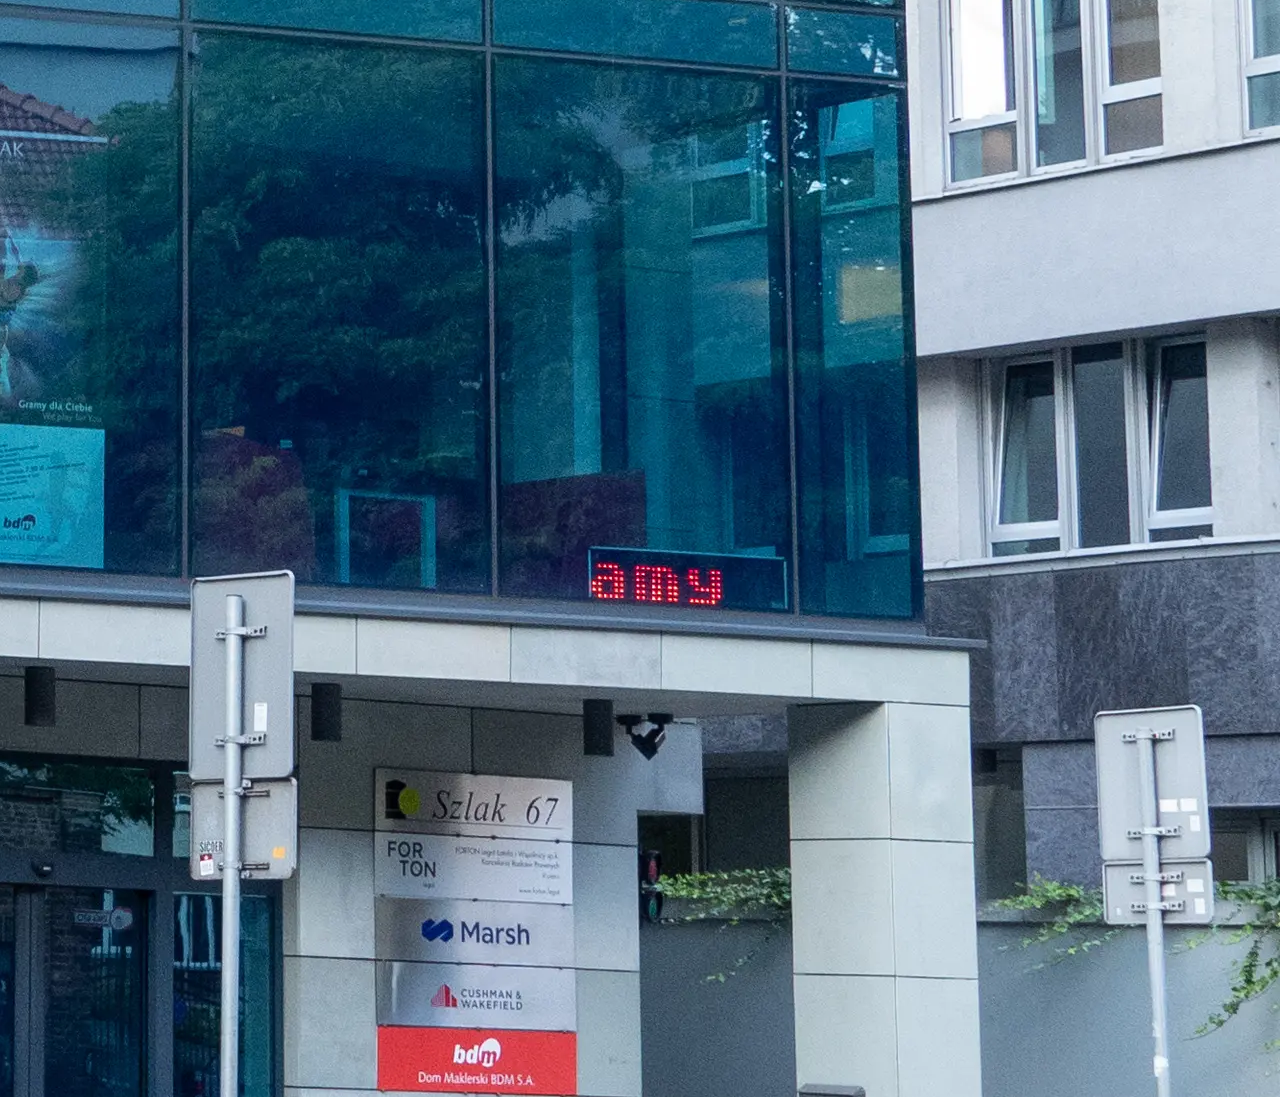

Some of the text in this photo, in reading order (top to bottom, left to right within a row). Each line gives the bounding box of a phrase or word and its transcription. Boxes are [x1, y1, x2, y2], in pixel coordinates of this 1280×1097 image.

[18, 399, 93, 413] Gramy dla Ciebie
[591, 562, 722, 605] amy
[431, 789, 560, 826] Szlak 67
[387, 840, 424, 859] FOR
[399, 860, 437, 878] TON
[460, 920, 531, 945] Marsh
[460, 988, 522, 1000] CUSHMAN &
[460, 999, 523, 1011] WAKEFIELD
[418, 1071, 442, 1083] Dom
[443, 1071, 489, 1085] Maklerski
[490, 1073, 515, 1086] BDM
